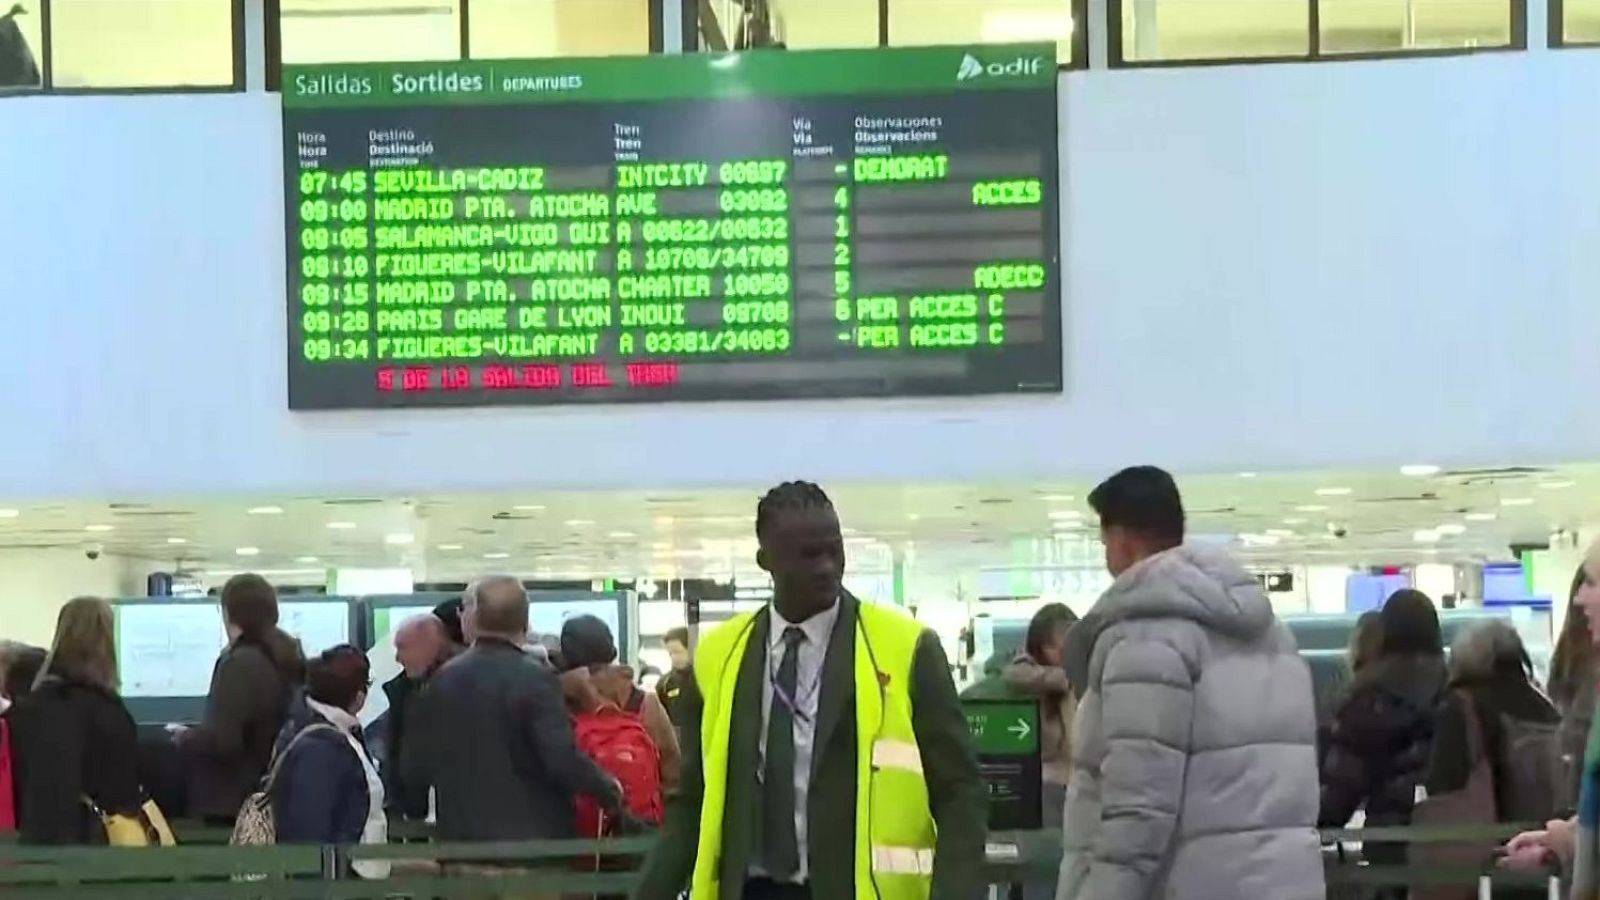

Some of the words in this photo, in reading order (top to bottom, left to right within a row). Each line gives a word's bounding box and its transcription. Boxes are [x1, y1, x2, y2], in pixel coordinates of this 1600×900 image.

[986, 56, 1043, 76] adif
[295, 73, 371, 95] Salidas
[392, 68, 483, 93] Sortides
[502, 74, 583, 92] DEPARTURES
[614, 123, 640, 136] Tren
[855, 115, 942, 129] Observaciones
[298, 131, 326, 143] Hora
[369, 130, 414, 142] Destino
[614, 138, 641, 150] Tren
[855, 129, 937, 143] Observacions
[299, 145, 327, 156] Hora
[369, 141, 434, 156] Destinació
[300, 171, 367, 194] 07:45
[374, 168, 543, 192] SEVILLA-CADIZ
[618, 163, 707, 187] INTCITY
[854, 155, 948, 182] DEMORAT
[301, 199, 367, 222] 09:00
[374, 198, 453, 220] MADRID
[465, 196, 515, 218] PTA.
[530, 193, 609, 217] ATOCHA
[616, 193, 656, 215] AVE
[835, 187, 847, 208] 4
[301, 227, 368, 250] 09:05
[375, 223, 558, 248] SALAMANCA-VIGO
[616, 220, 631, 243] A
[836, 215, 848, 237] 1
[376, 250, 596, 276] FIGUERES-VILAFANT
[617, 249, 632, 271] A
[835, 243, 849, 265] 2
[302, 283, 369, 305] 09:15
[376, 281, 454, 303] MADRID
[466, 280, 516, 301] PTA.
[532, 277, 610, 300] ATOCHA
[618, 275, 710, 298] CHARTER
[835, 271, 849, 293] 5
[377, 309, 442, 331] PARIS
[454, 308, 507, 329] GARE
[519, 307, 546, 328] DE
[558, 305, 611, 327] LYON
[620, 304, 685, 325] INOUI
[835, 298, 850, 320] 6
[857, 297, 897, 319] PER
[910, 295, 977, 318] ACCES
[989, 294, 1003, 316] C
[303, 339, 368, 360] 09:34
[377, 333, 598, 359] FIGUERES-VILAFANT
[619, 332, 633, 353] A
[858, 326, 898, 347] PER
[910, 323, 977, 345] ACCES
[989, 323, 1003, 344] C
